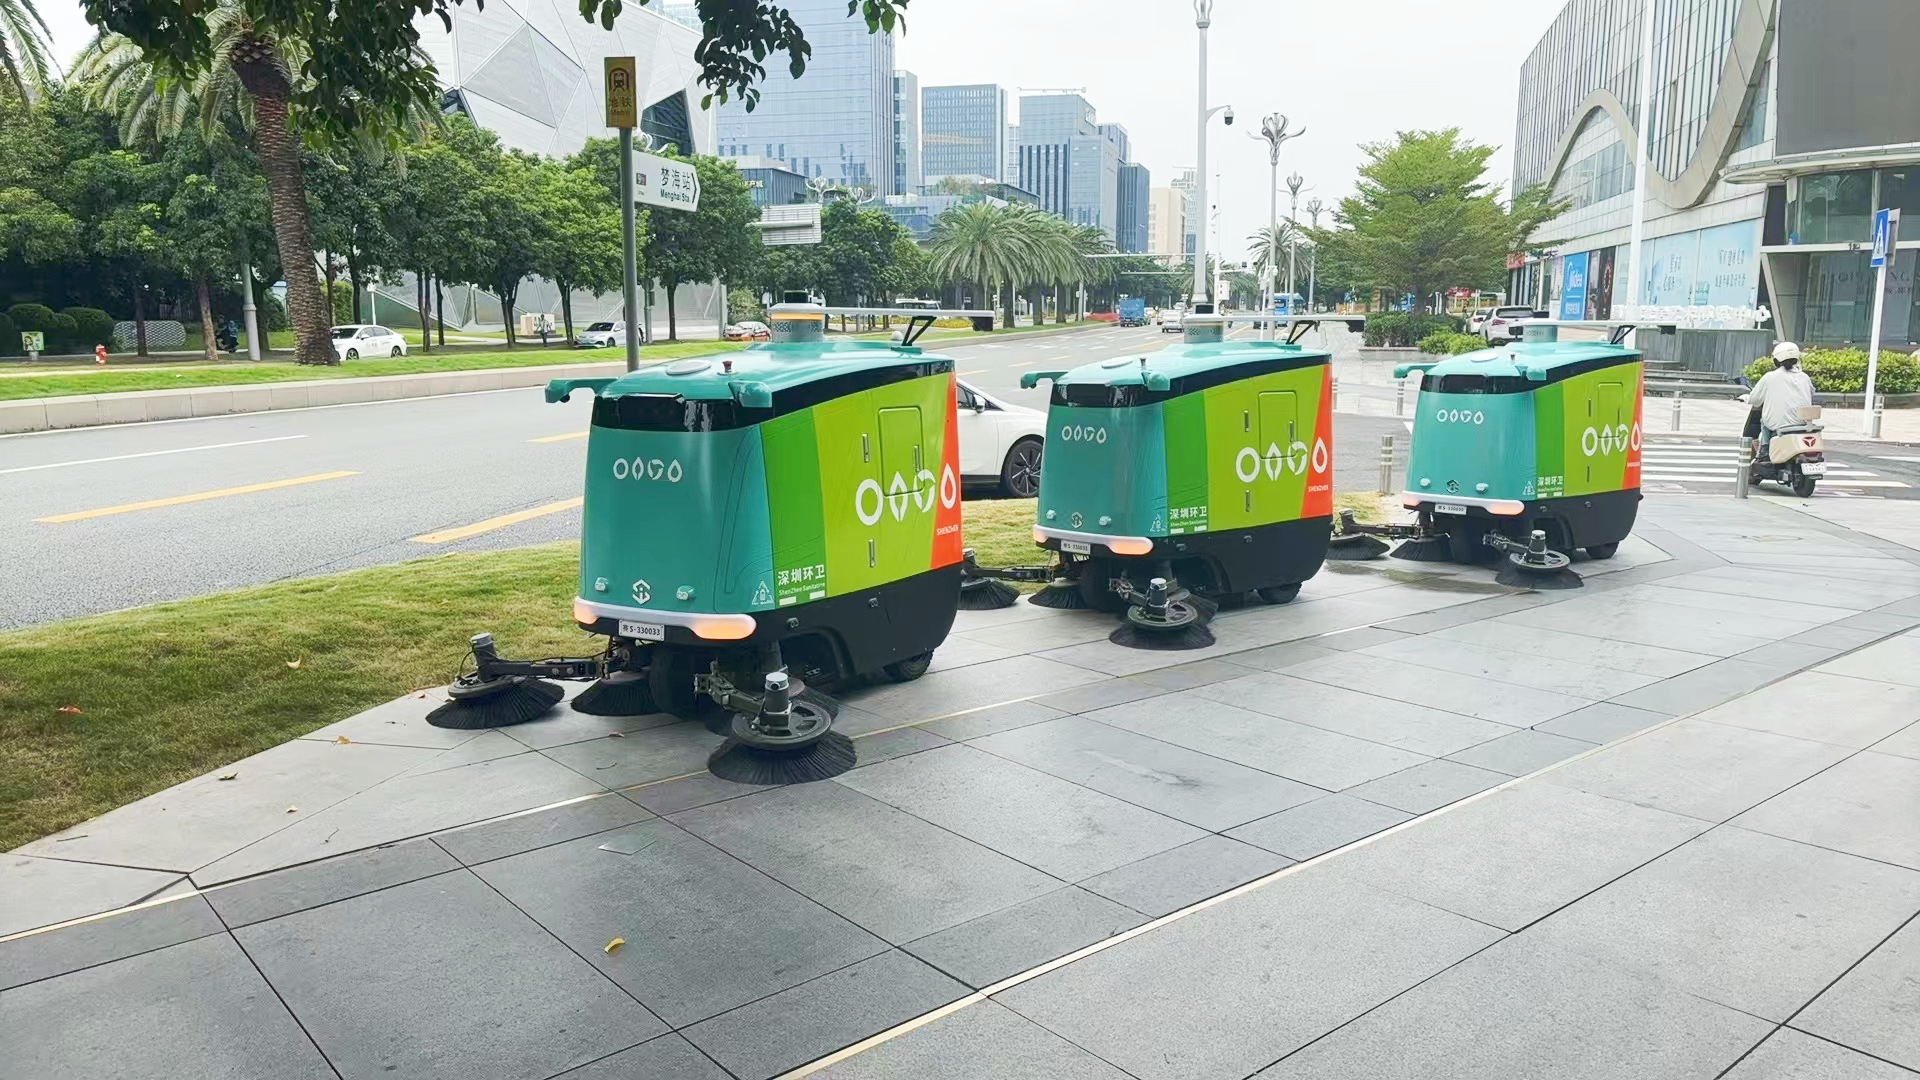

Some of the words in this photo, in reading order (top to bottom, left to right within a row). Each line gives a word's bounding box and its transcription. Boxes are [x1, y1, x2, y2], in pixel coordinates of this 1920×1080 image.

[608, 96, 632, 108] 地铁
[660, 166, 691, 191] 梦海站
[660, 188, 682, 202] Menghai
[1537, 475, 1563, 487] 深圳环卫
[1169, 505, 1207, 520] 深圳环卫
[936, 524, 959, 536] SHENZHEN
[777, 564, 825, 586] 深圳环卫
